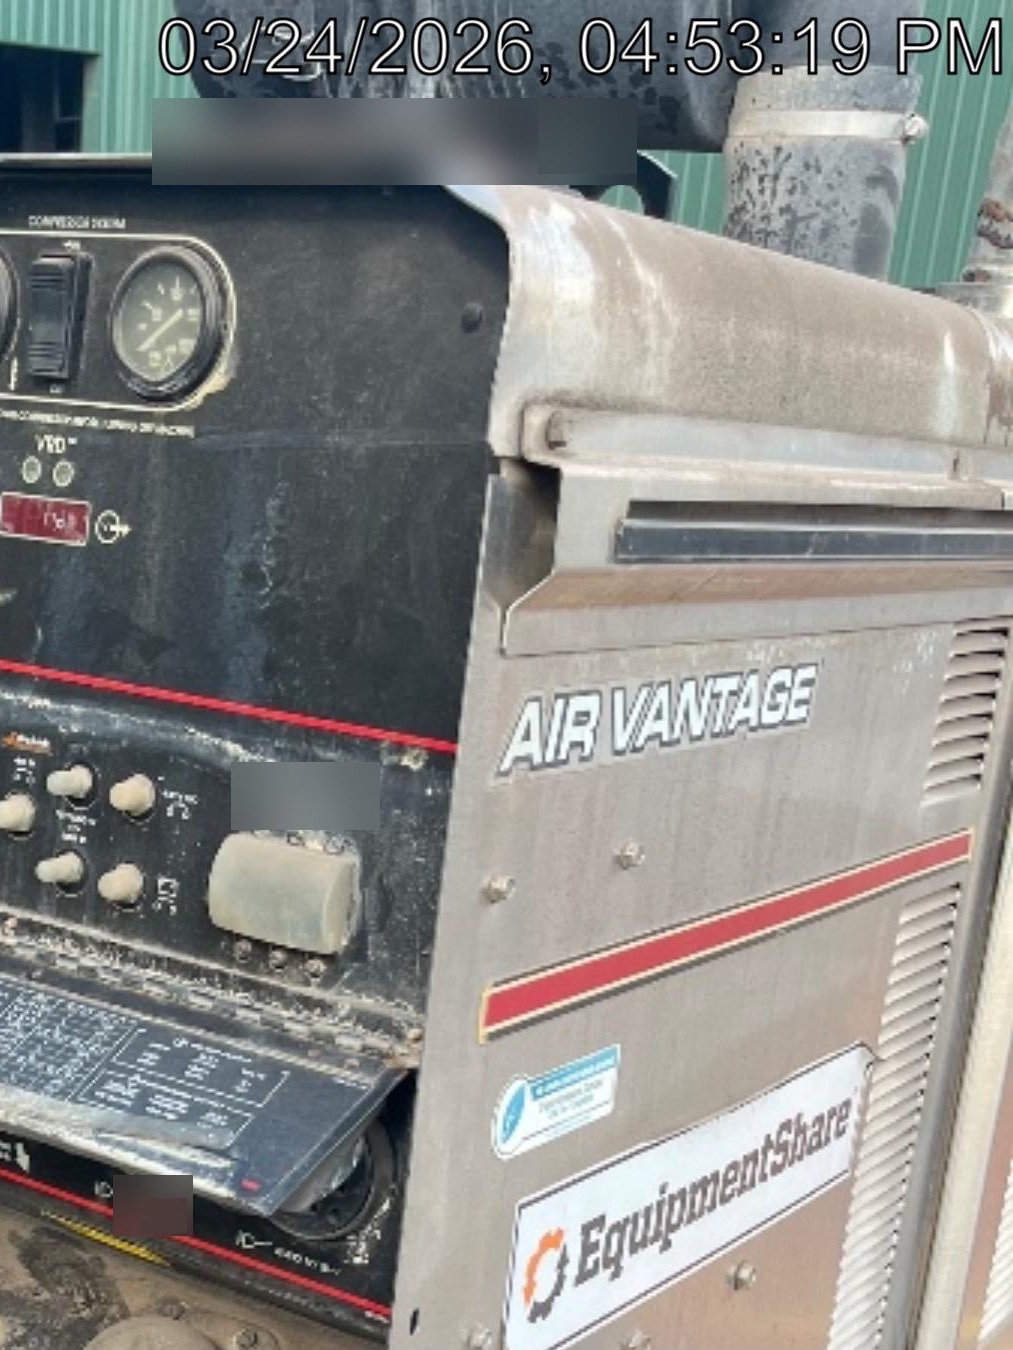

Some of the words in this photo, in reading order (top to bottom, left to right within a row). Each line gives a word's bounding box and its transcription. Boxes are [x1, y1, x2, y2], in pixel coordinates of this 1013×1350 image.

[496, 689, 602, 776] AIR
[611, 662, 818, 756] VANTAGE
[573, 1096, 853, 1289] EquipmentShare
